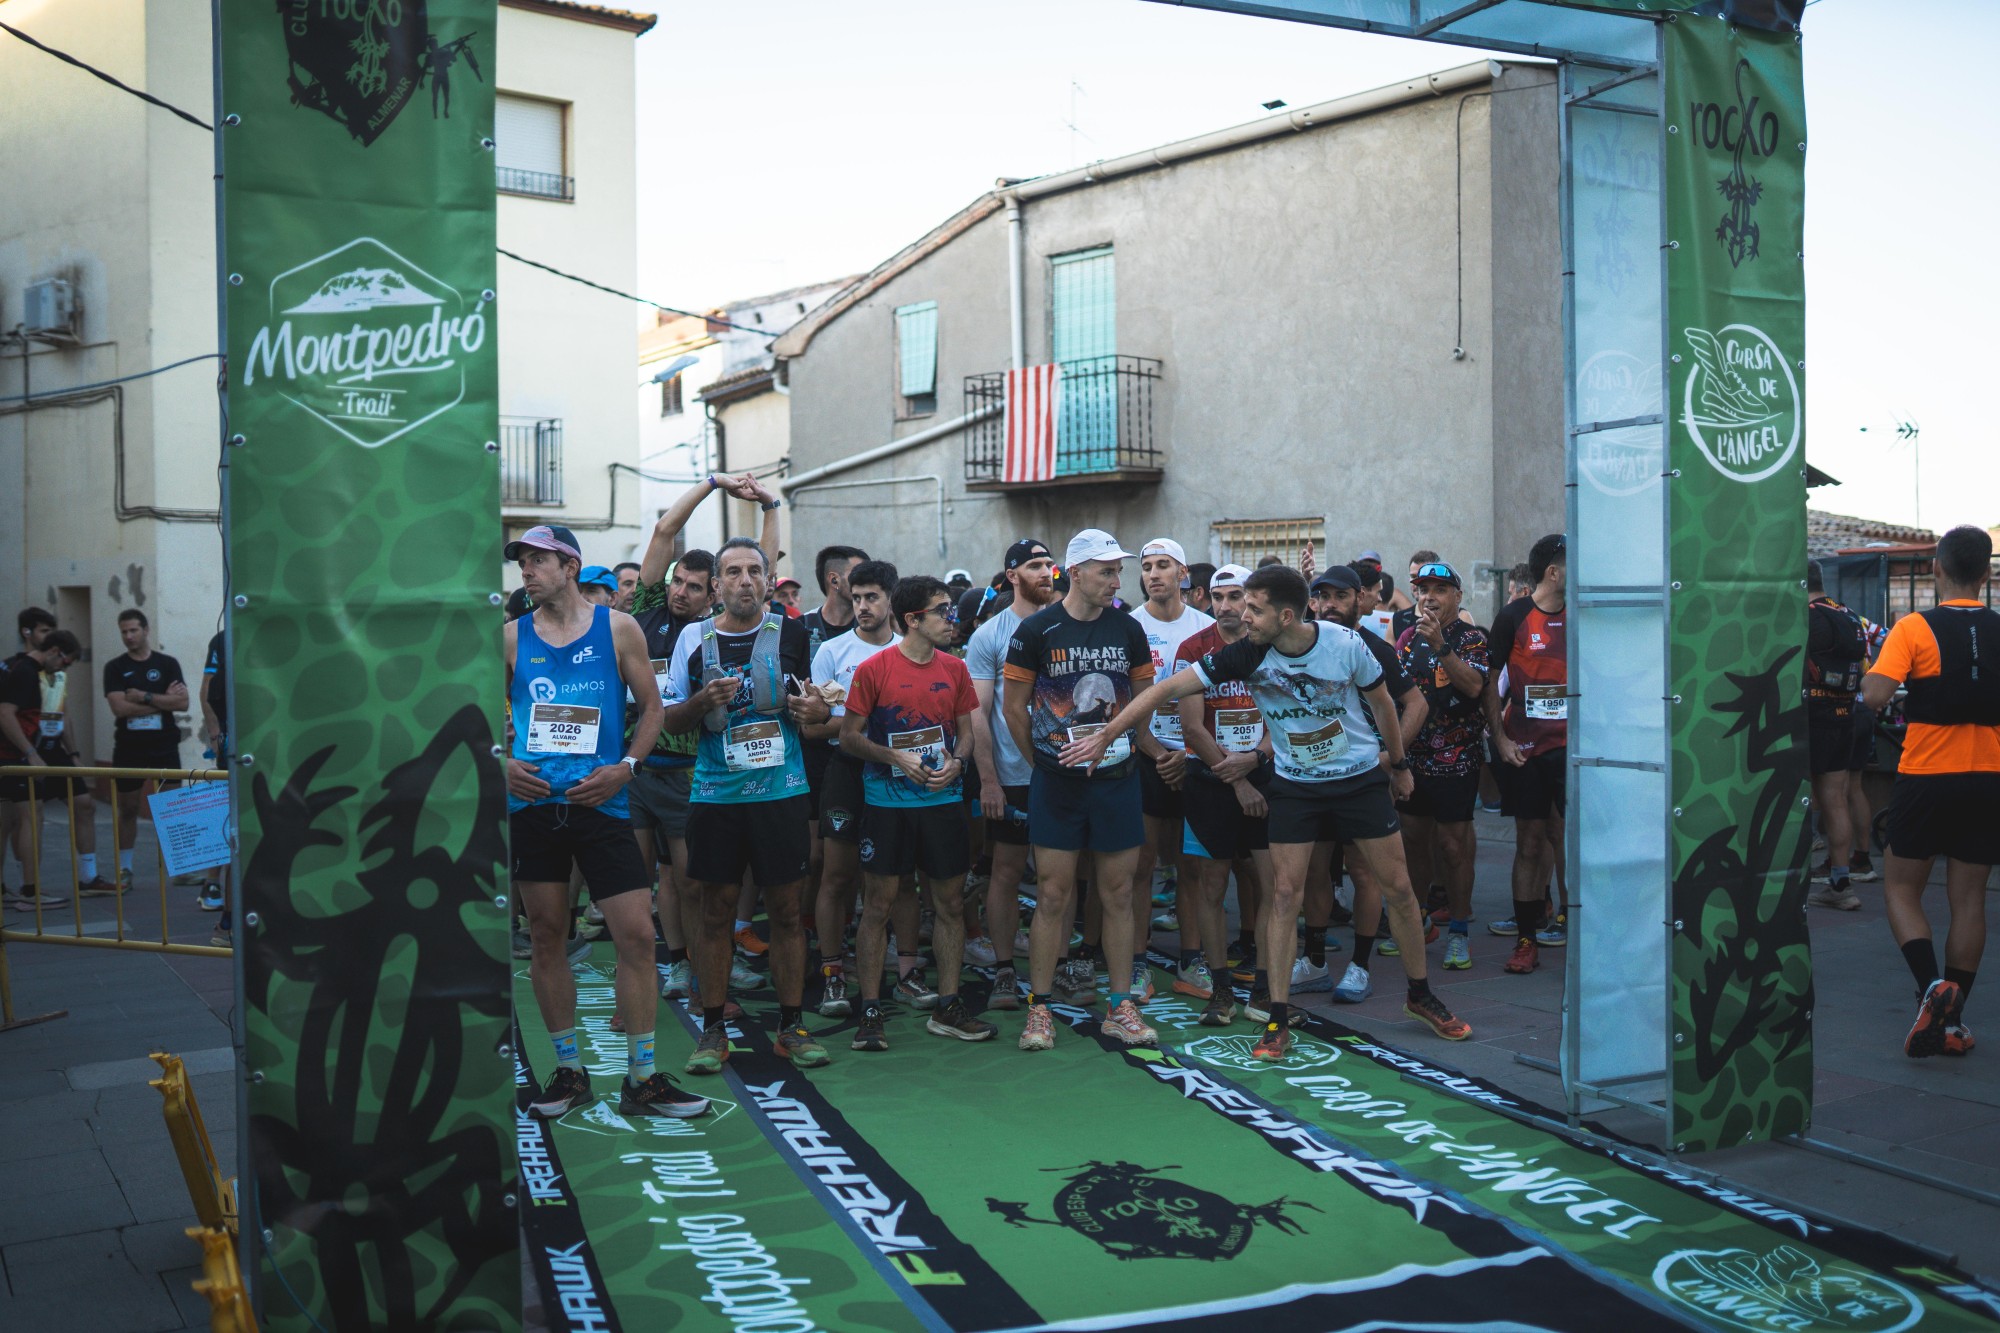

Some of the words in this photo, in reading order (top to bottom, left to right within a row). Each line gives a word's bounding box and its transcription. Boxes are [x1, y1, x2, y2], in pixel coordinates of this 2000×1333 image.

[367, 76, 412, 131] ALMENAR
[244, 299, 486, 386] Montpedró
[1725, 338, 1773, 371] CURSA
[1759, 376, 1779, 399] DE
[343, 391, 392, 417] Trail
[561, 681, 605, 694] RAMOS
[1541, 699, 1564, 707] 1950
[549, 723, 582, 734] 2026
[1232, 725, 1255, 734] 2051
[743, 739, 772, 751] 1959
[1306, 739, 1333, 753] 1924
[1334, 1035, 1519, 1106] FIREHAWK
[1285, 1074, 1407, 1119] CURSA
[1384, 1120, 1457, 1144] DE
[516, 1104, 567, 1206] FIREHAWK
[744, 1080, 966, 1286] FIREHAWK
[1835, 1301, 1880, 1319] DE
